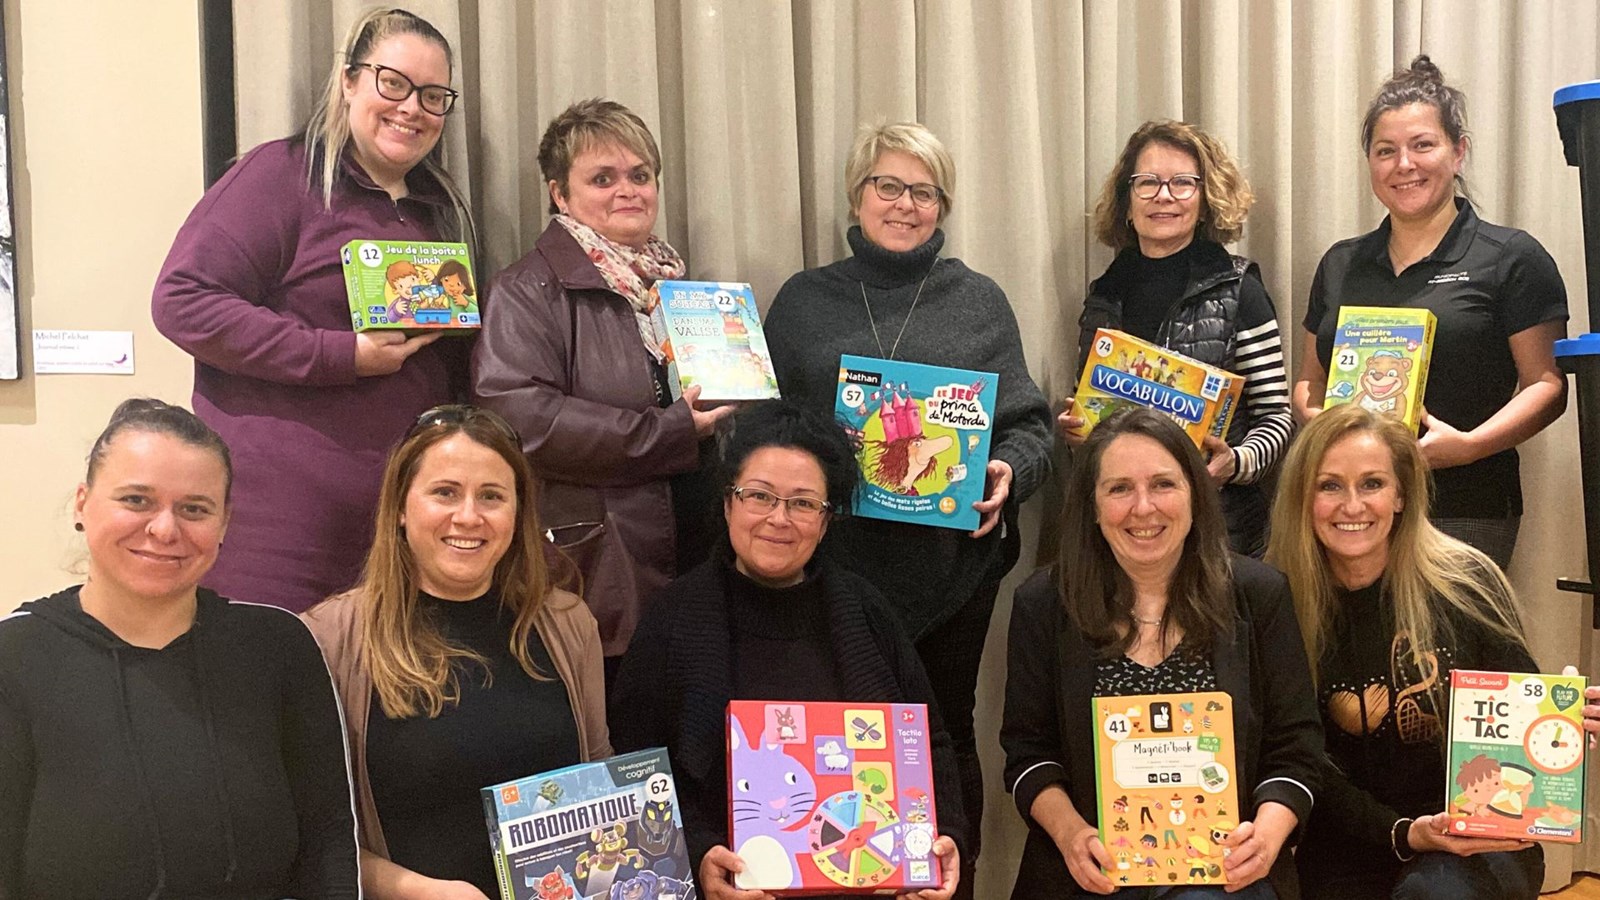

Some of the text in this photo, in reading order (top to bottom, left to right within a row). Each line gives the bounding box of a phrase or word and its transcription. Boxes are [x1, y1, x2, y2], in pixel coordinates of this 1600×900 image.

[364, 249, 379, 259] 12
[385, 244, 402, 254] Jeu
[405, 245, 417, 254] de
[420, 246, 429, 254] la
[413, 256, 440, 265] lunch
[718, 296, 732, 305] 22
[675, 326, 720, 336] VALISE
[1099, 340, 1111, 352] 74
[1340, 355, 1355, 365] 21
[845, 372, 878, 383] Nathan
[846, 390, 861, 401] 57
[937, 387, 974, 401] LE JEU
[1098, 368, 1200, 418] VOCABULON
[940, 399, 978, 414] prince
[929, 410, 985, 426] de Motordu
[1524, 684, 1543, 697] 58
[1474, 700, 1509, 717] TIC
[903, 712, 914, 720] 3+
[1109, 720, 1128, 733] 41
[1470, 718, 1509, 739] TAC
[618, 757, 660, 772] Développement
[626, 764, 656, 779] cognitif
[651, 779, 669, 794] 62
[504, 789, 516, 800] 6+
[508, 793, 639, 848] ROBOMATIQUE
